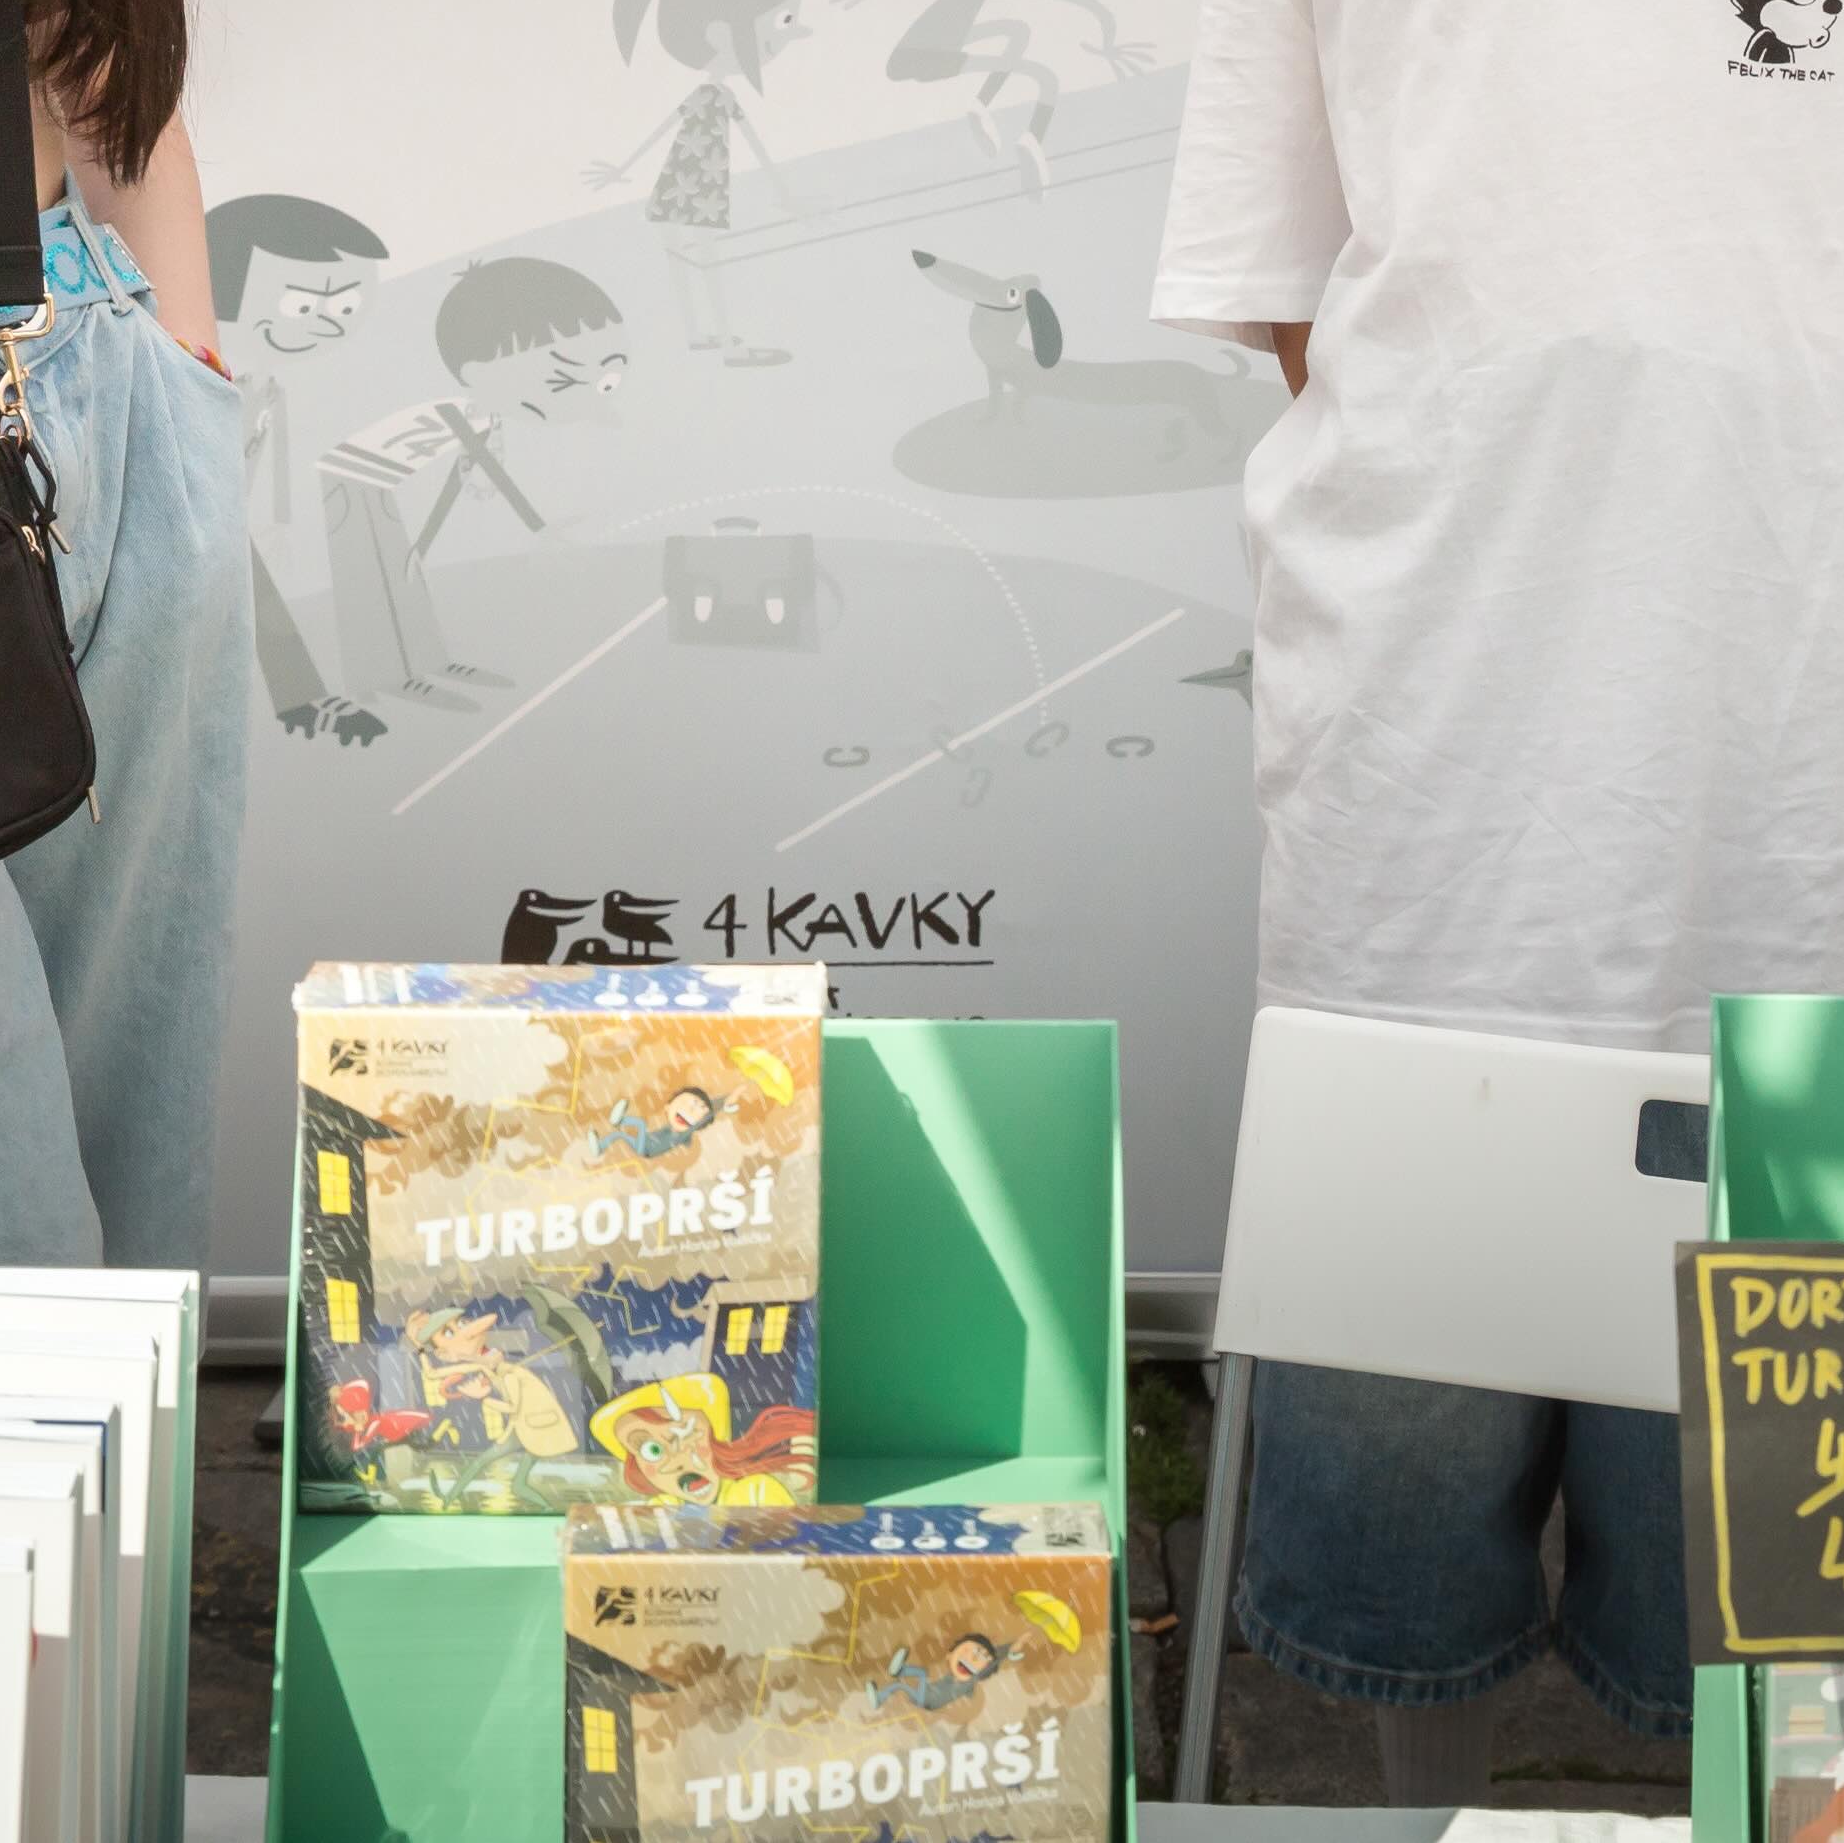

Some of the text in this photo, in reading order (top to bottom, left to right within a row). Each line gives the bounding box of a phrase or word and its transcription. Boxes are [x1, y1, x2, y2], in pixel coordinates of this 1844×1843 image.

[1727, 60, 1836, 83] FELIX THE CAT
[703, 886, 995, 957] 4 KAVKY
[415, 1166, 775, 1269] TURBOPRŠÍ
[685, 1717, 1061, 1829] TURBOPRŠÍ
